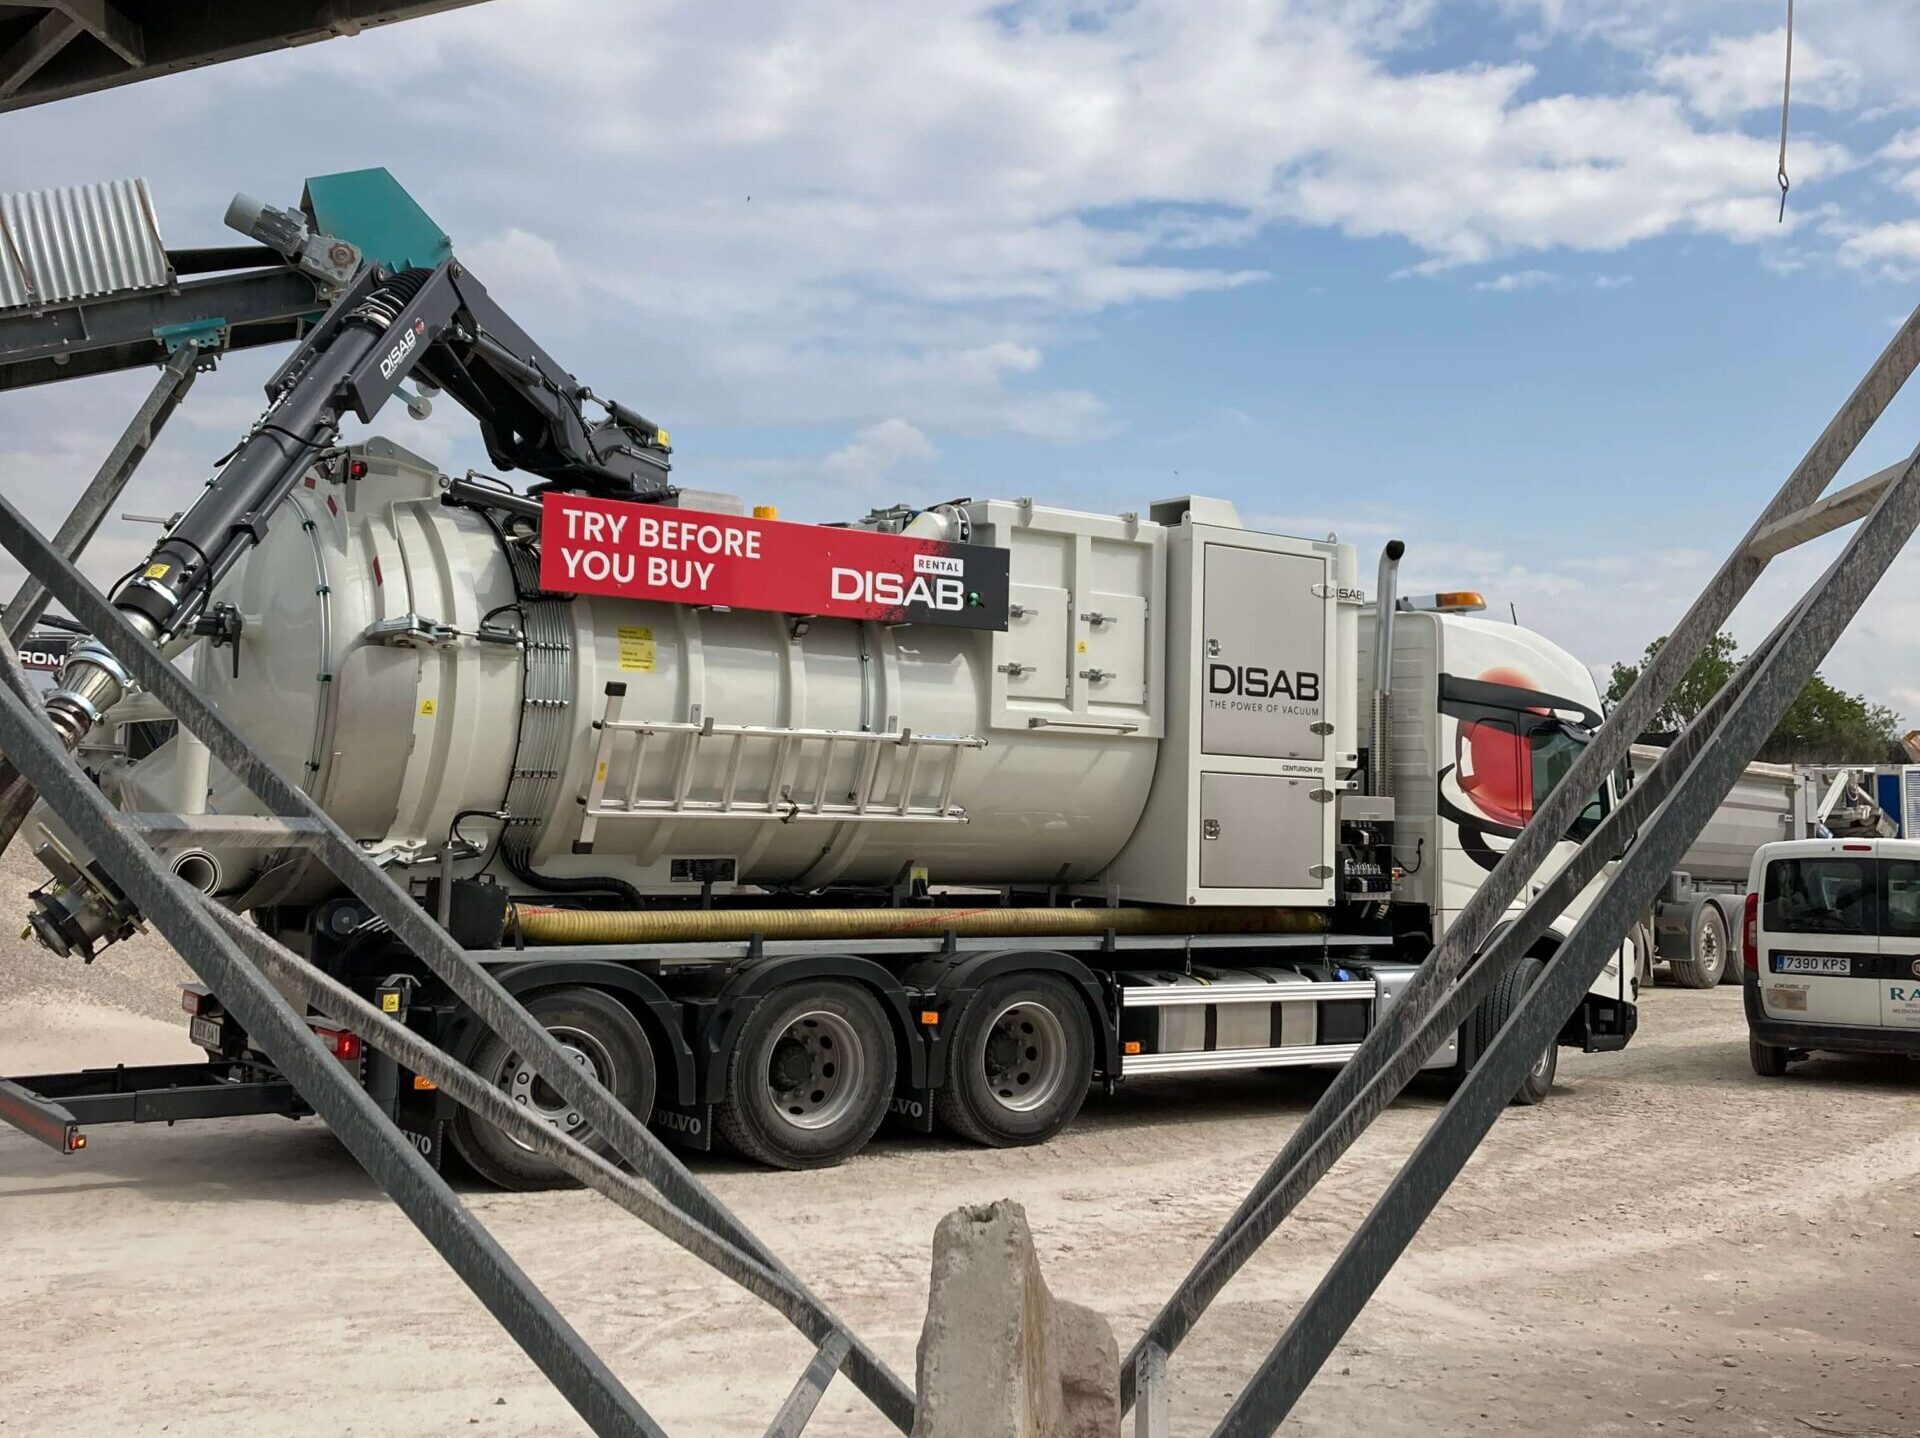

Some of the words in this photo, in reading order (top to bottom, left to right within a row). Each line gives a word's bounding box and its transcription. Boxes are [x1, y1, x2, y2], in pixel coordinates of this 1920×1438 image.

[380, 328, 415, 377] DISAB
[562, 508, 628, 544] TRY
[639, 517, 761, 560] BEFORE
[561, 547, 635, 583] YOU
[648, 557, 715, 591] BUY
[918, 558, 960, 572] RENTAL
[831, 567, 964, 611] DISAB
[1209, 663, 1319, 701] DISAB
[1209, 700, 1227, 709] THE
[1231, 701, 1263, 712] POWER
[1266, 704, 1278, 713] OF
[1282, 706, 1319, 716] VACUUM
[1786, 957, 1818, 969] 7390
[1822, 959, 1847, 971] KPS
[658, 1110, 701, 1135] OLVO
[889, 1097, 923, 1117] LVO
